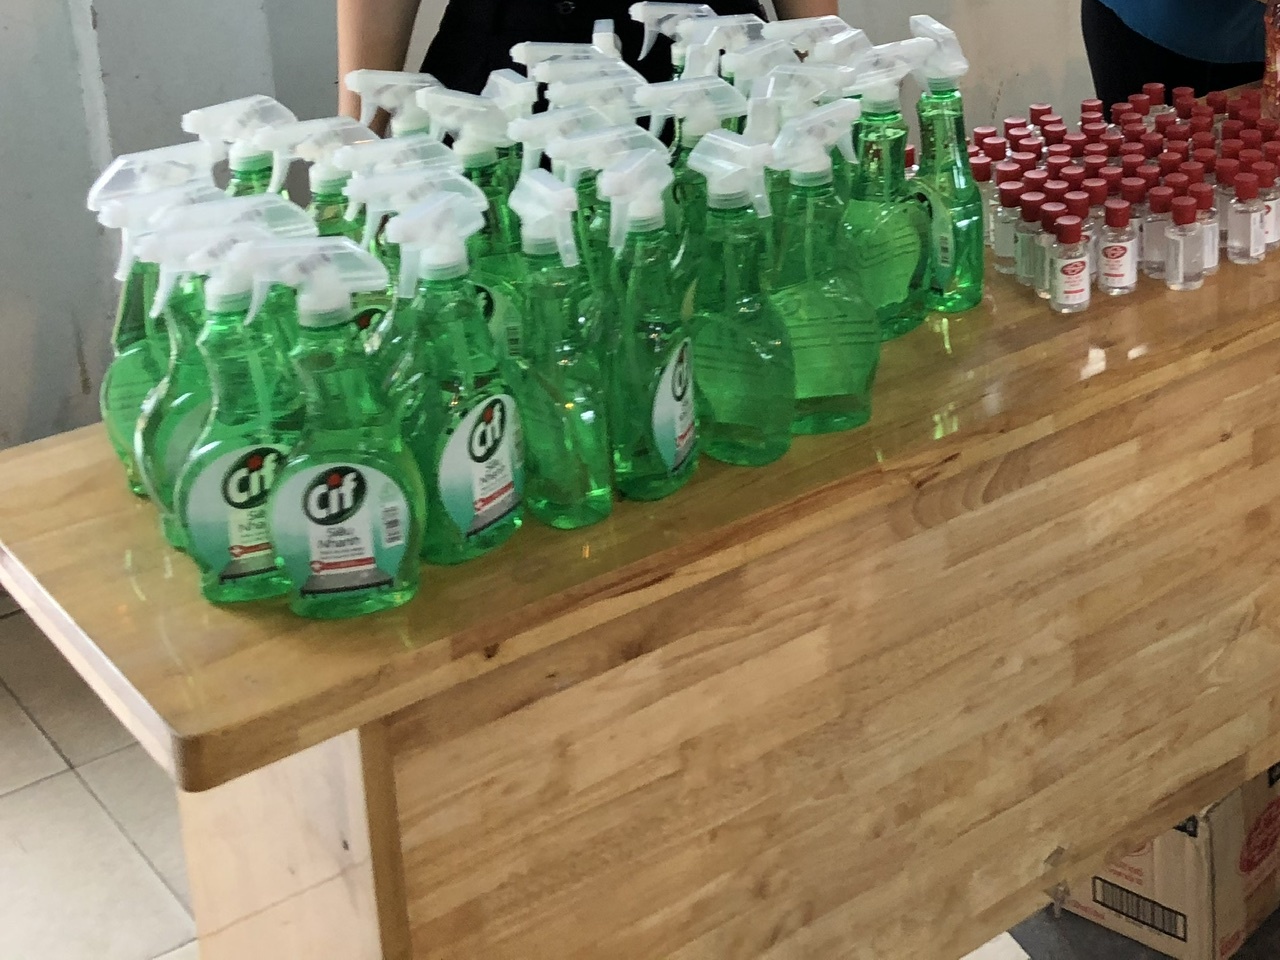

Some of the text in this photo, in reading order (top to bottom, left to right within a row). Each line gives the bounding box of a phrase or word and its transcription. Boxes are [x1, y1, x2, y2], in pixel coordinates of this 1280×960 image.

[472, 403, 503, 457] Cif
[228, 453, 279, 503] Cif
[307, 470, 358, 519] Cif
